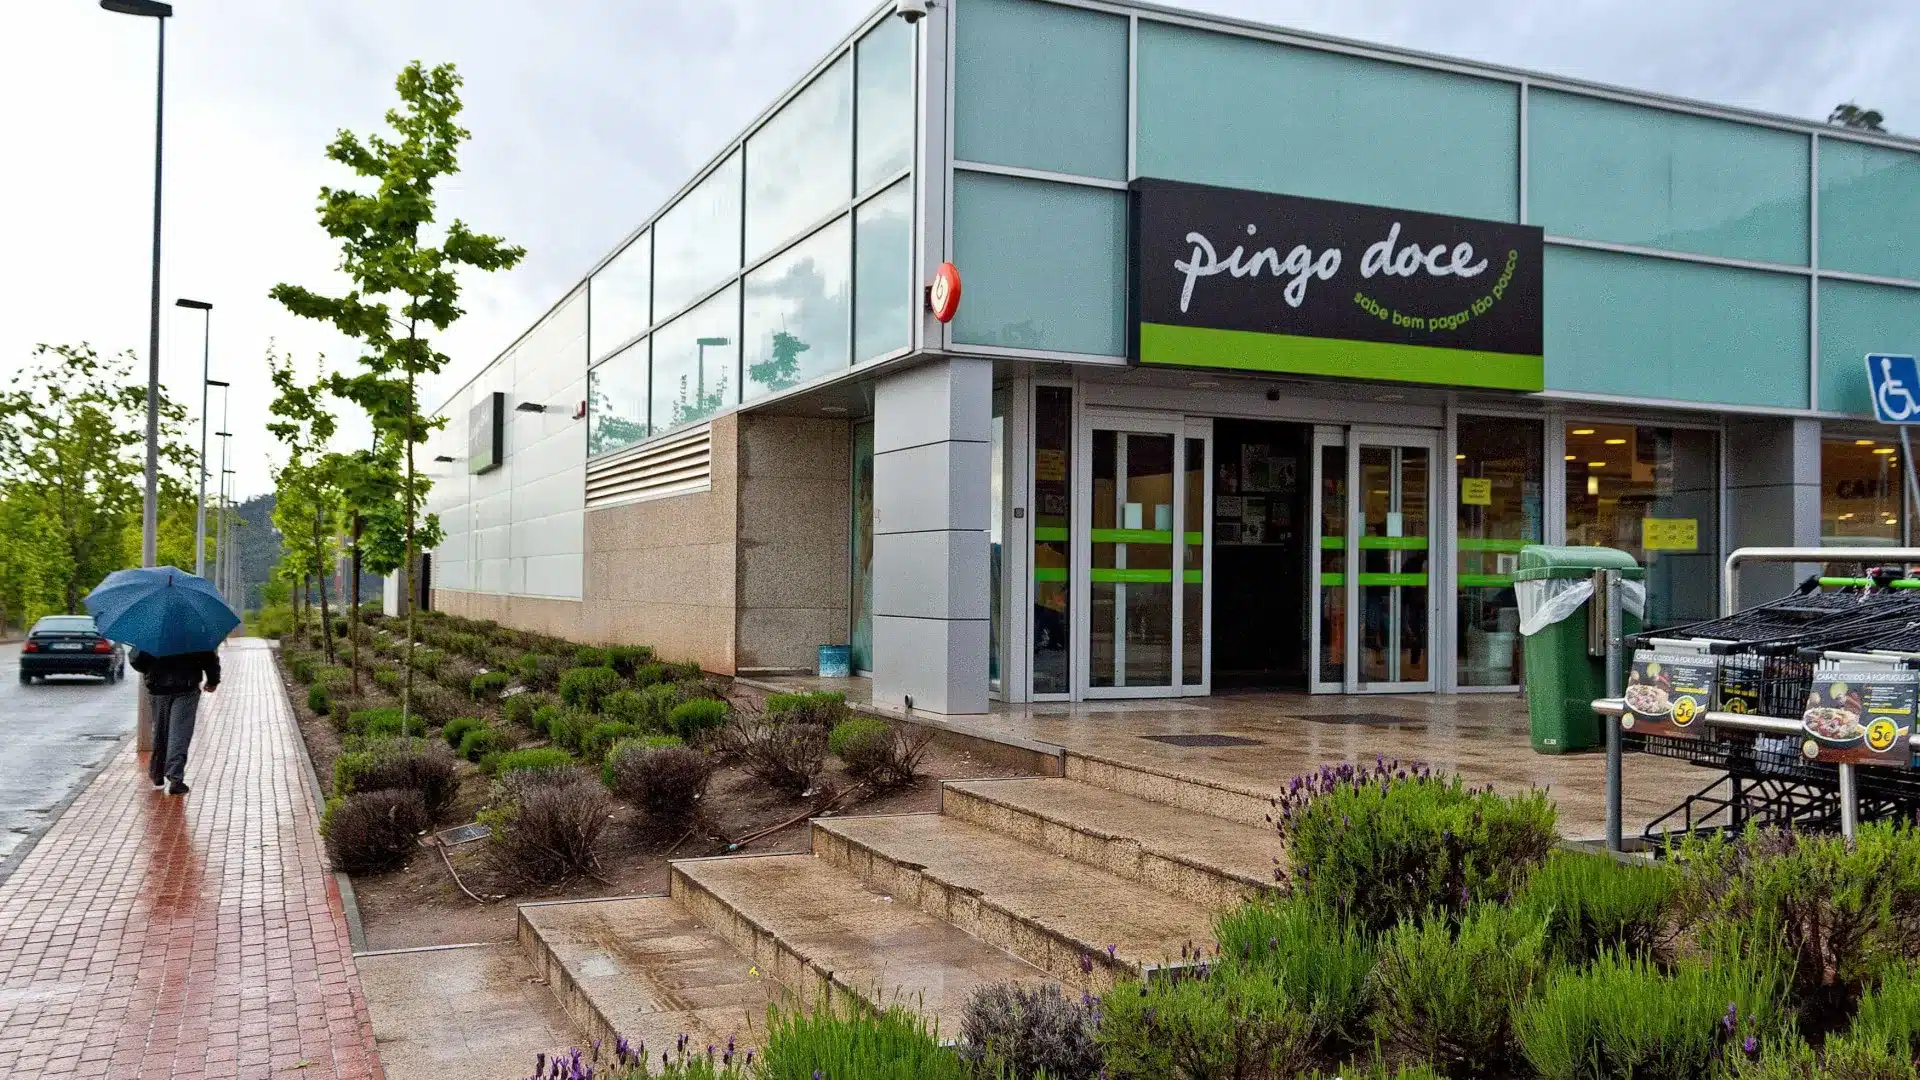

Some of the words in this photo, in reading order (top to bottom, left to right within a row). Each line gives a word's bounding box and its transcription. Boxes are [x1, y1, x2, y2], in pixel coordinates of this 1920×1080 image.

[1174, 223, 1341, 313] pingo
[1360, 222, 1488, 278] doce
[1354, 291, 1388, 320] sabe
[1392, 309, 1425, 329] bem
[1429, 309, 1470, 332] pagar
[1471, 295, 1493, 316] tão
[1493, 249, 1518, 300] pouco
[1677, 703, 1692, 718] 5€
[1872, 725, 1891, 742] 5€
